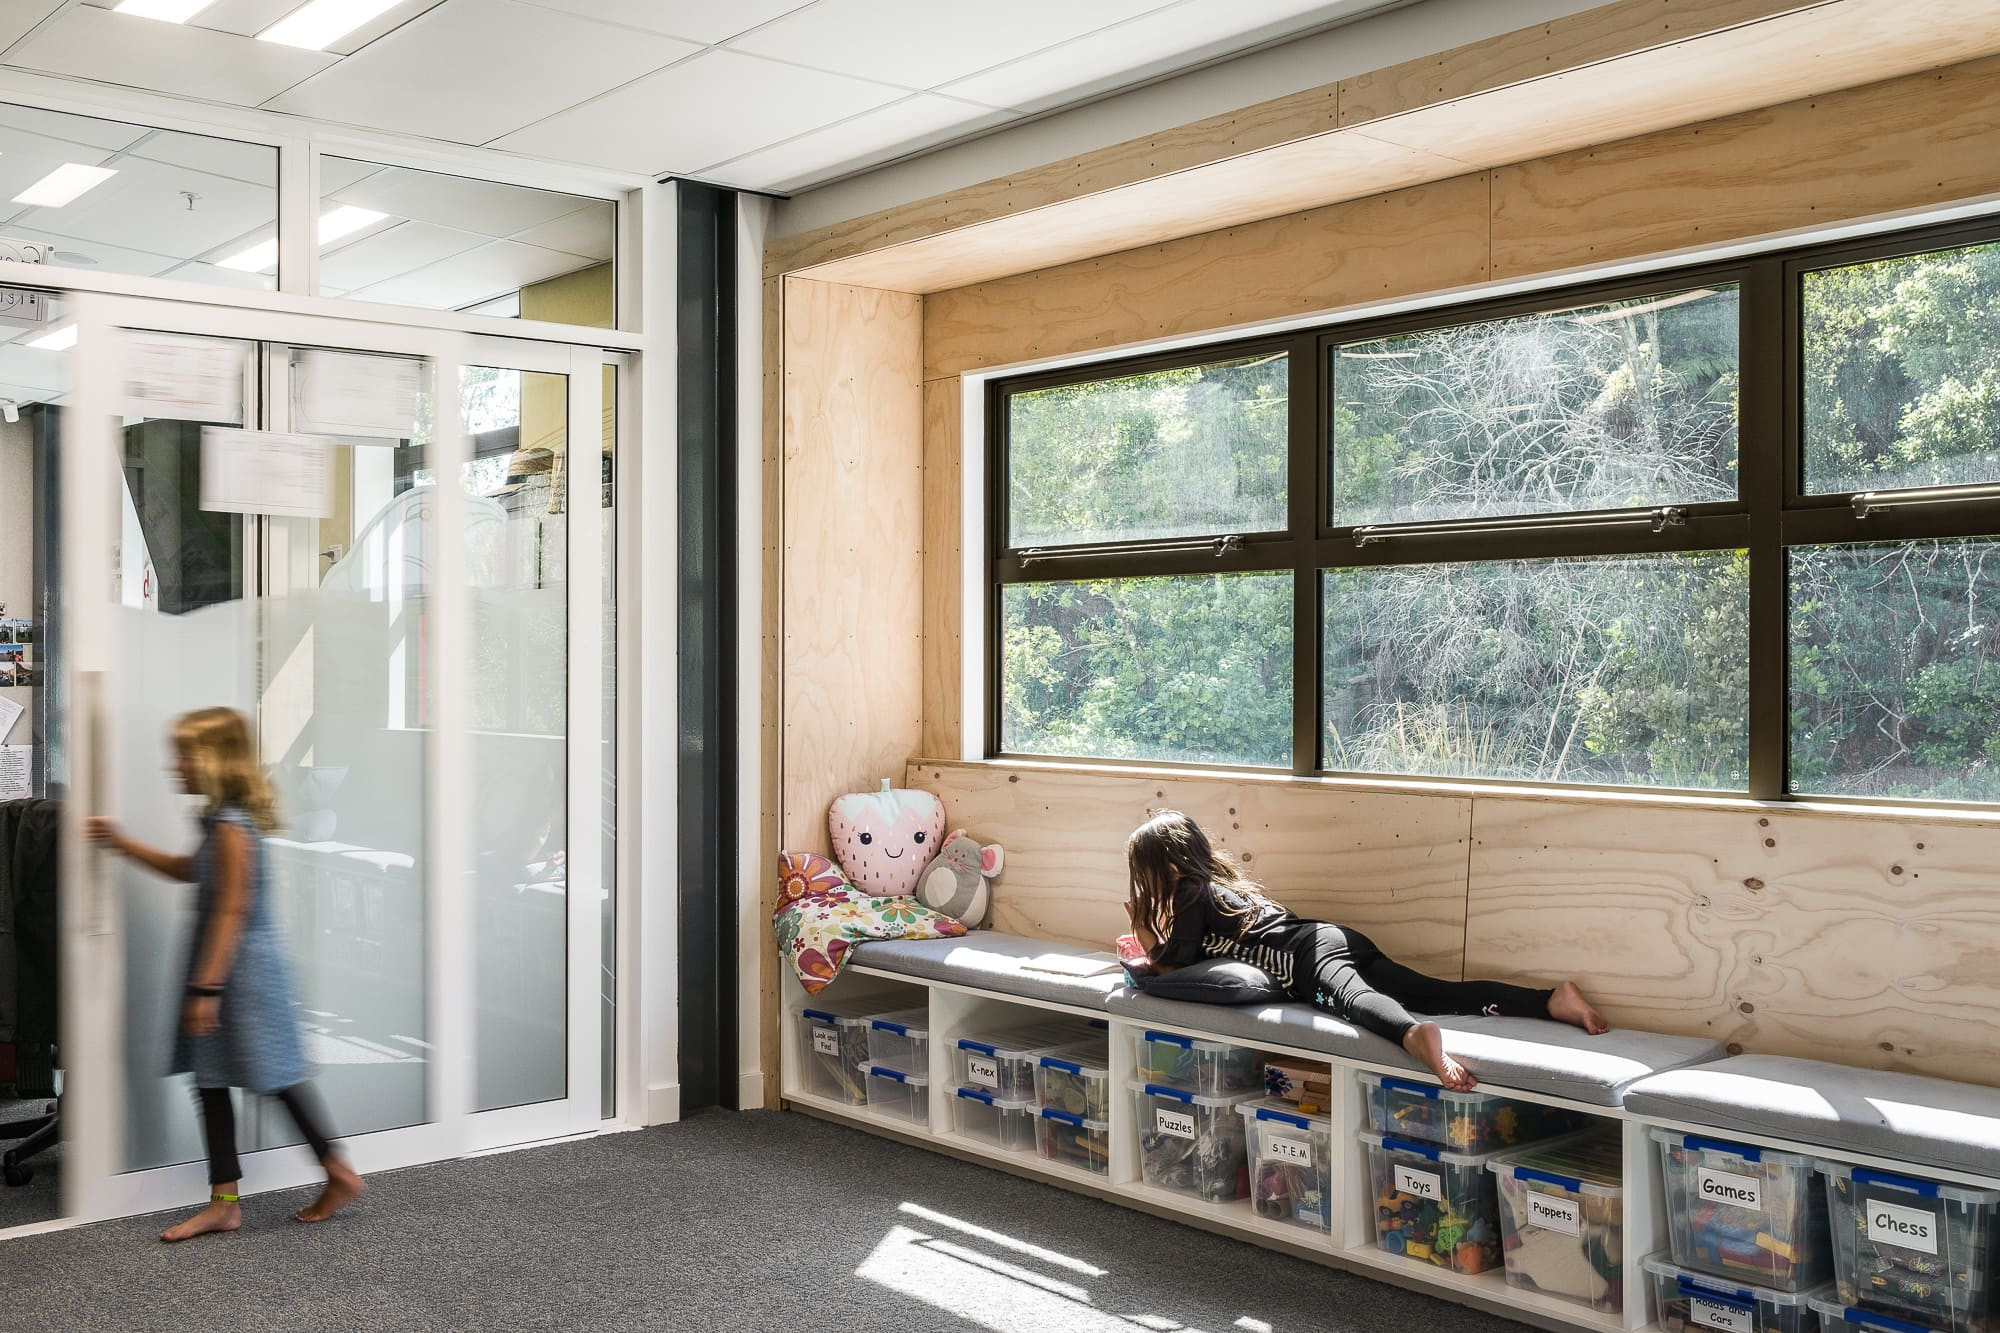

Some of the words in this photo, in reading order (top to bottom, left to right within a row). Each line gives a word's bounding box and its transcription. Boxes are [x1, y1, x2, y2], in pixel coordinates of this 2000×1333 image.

[814, 1030, 826, 1040] Look
[820, 1041, 832, 1051] Find
[970, 1061, 995, 1078] K-nex
[1159, 1116, 1192, 1134] Puzzles
[1272, 1143, 1307, 1160] S.T.E.M
[1404, 1175, 1431, 1195] Toys
[1702, 1178, 1756, 1202] Games
[1533, 1201, 1573, 1221] Puppets
[1875, 1213, 1928, 1238] Chess
[1710, 1312, 1733, 1327] Cars
